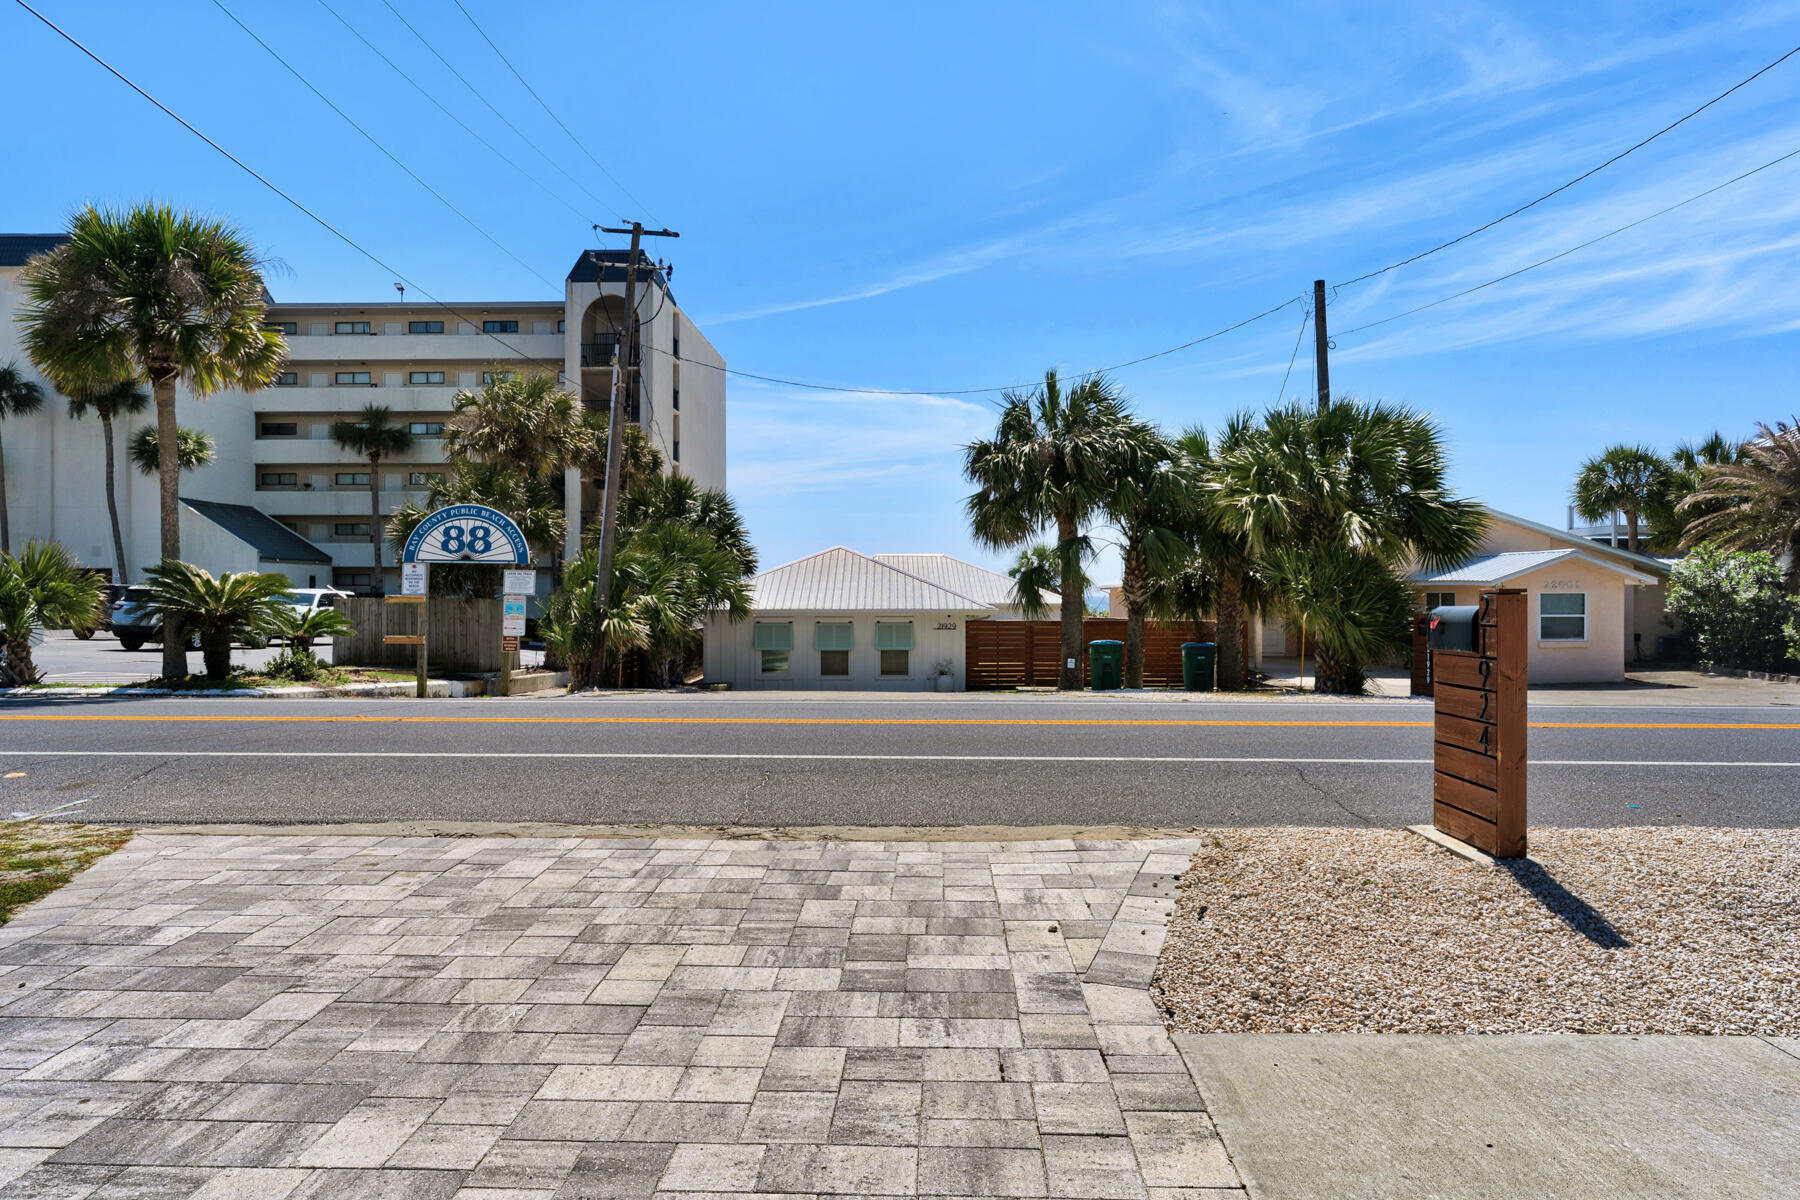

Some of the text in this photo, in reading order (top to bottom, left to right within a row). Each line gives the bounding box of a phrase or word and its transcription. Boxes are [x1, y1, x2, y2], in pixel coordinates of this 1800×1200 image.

[409, 508, 524, 553] BAY COUNTY PUBLIC BEACH ACCESS
[441, 525, 492, 554] 88
[936, 622, 957, 630] 21929
[1478, 594, 1490, 755] 21924
